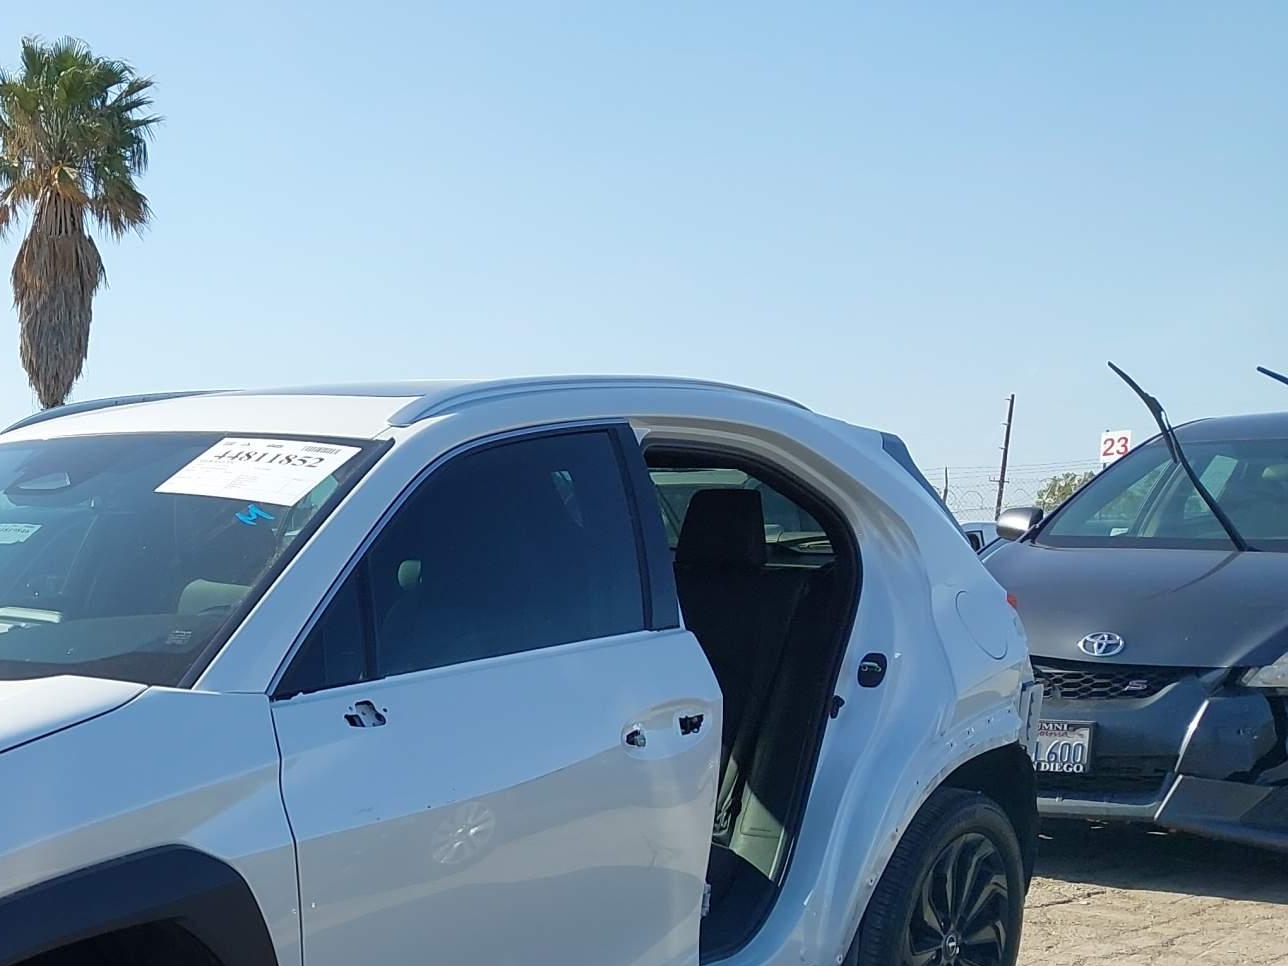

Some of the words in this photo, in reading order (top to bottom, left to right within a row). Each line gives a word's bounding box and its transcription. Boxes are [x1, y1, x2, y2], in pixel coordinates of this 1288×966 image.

[1102, 436, 1129, 457] 23
[214, 450, 325, 468] 44811852
[1040, 762, 1084, 773] DIEGO
